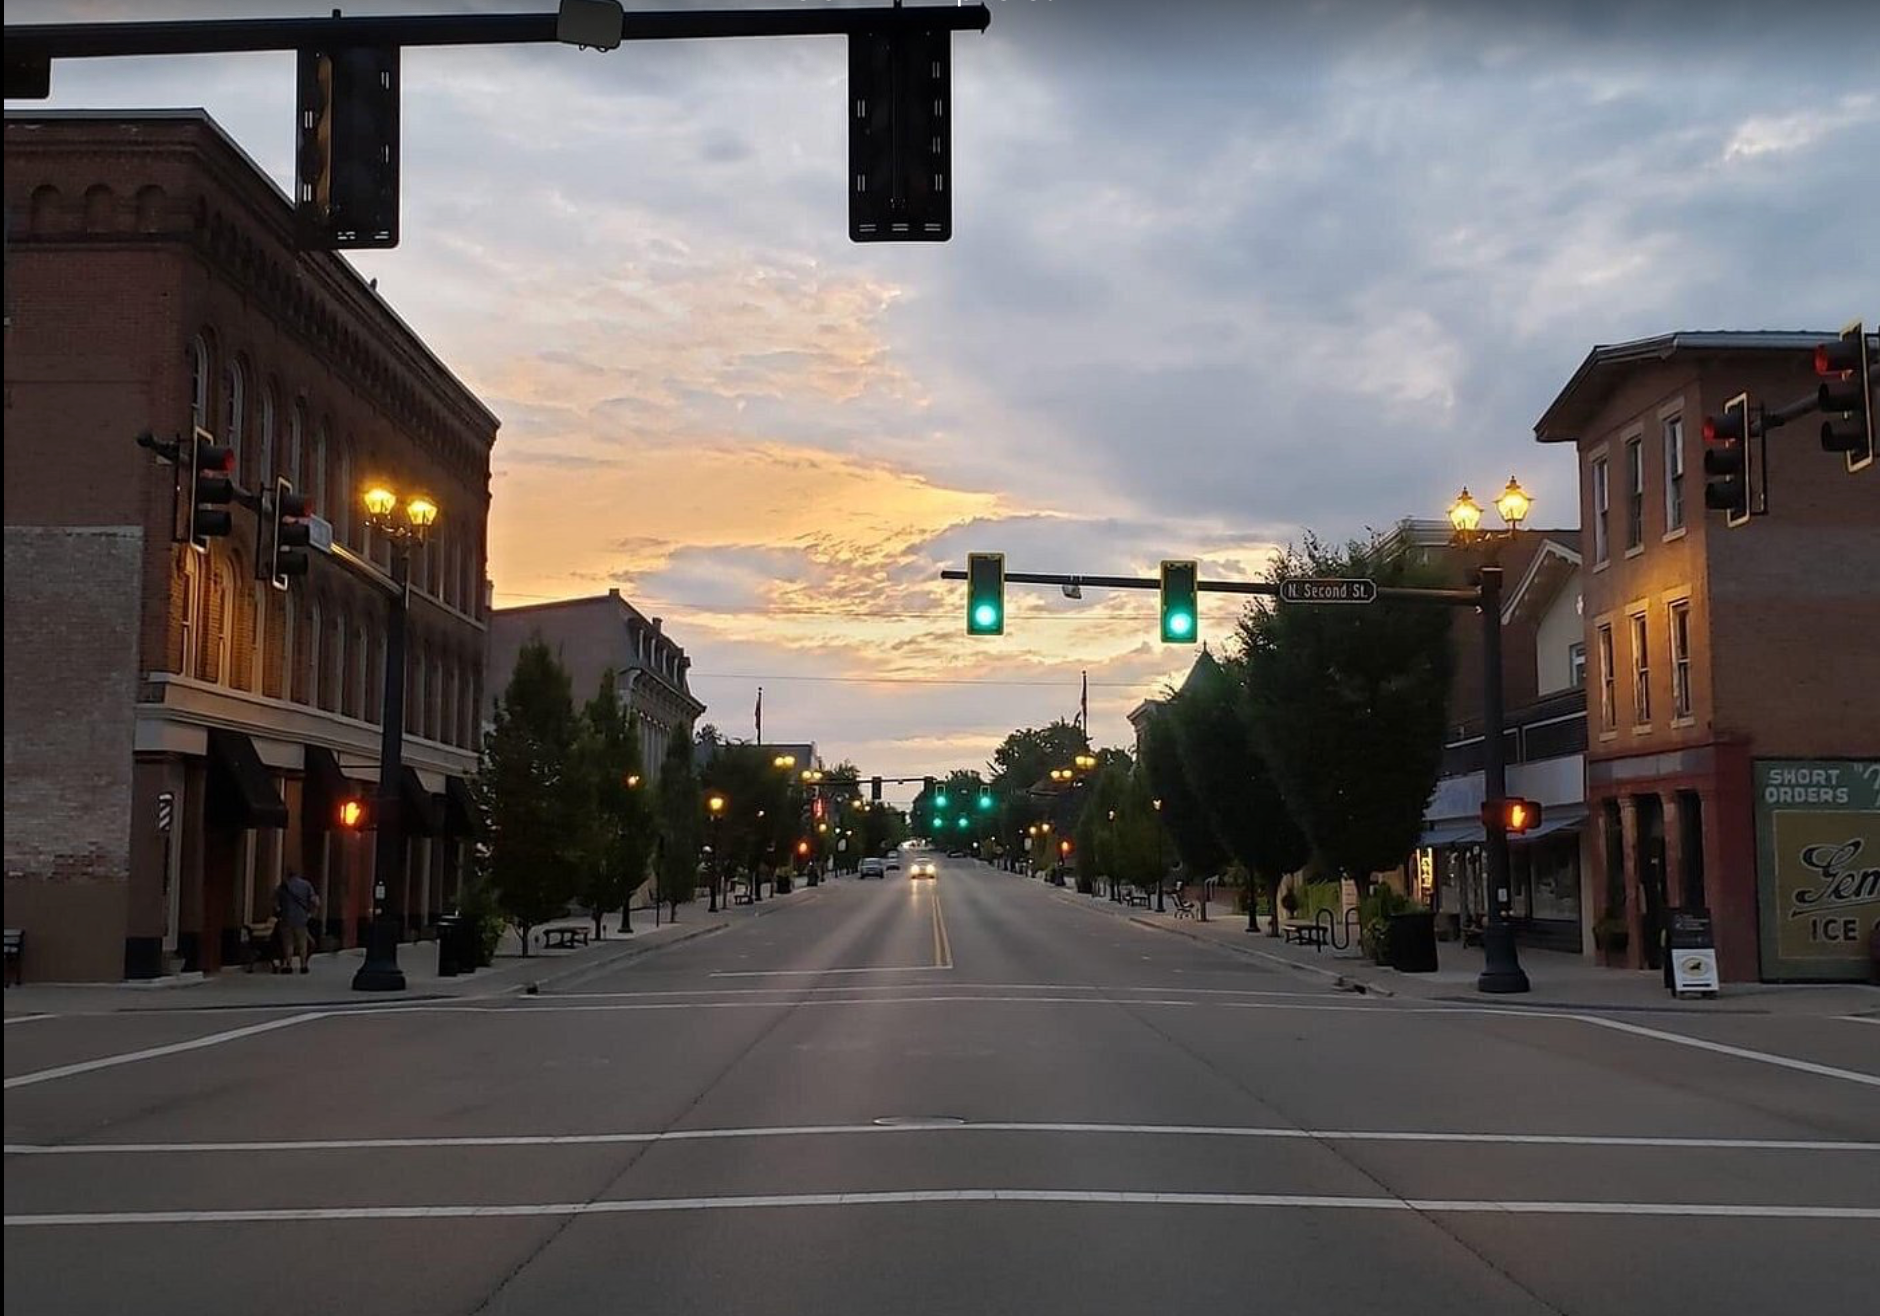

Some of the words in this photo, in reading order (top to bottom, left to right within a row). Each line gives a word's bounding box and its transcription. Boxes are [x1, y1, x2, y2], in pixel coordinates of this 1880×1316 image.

[1303, 582, 1347, 598] Second
[1352, 583, 1368, 598] St.
[1768, 768, 1841, 786] SHORT
[1764, 786, 1850, 804] ORDERS
[1809, 917, 1859, 943] ICE
